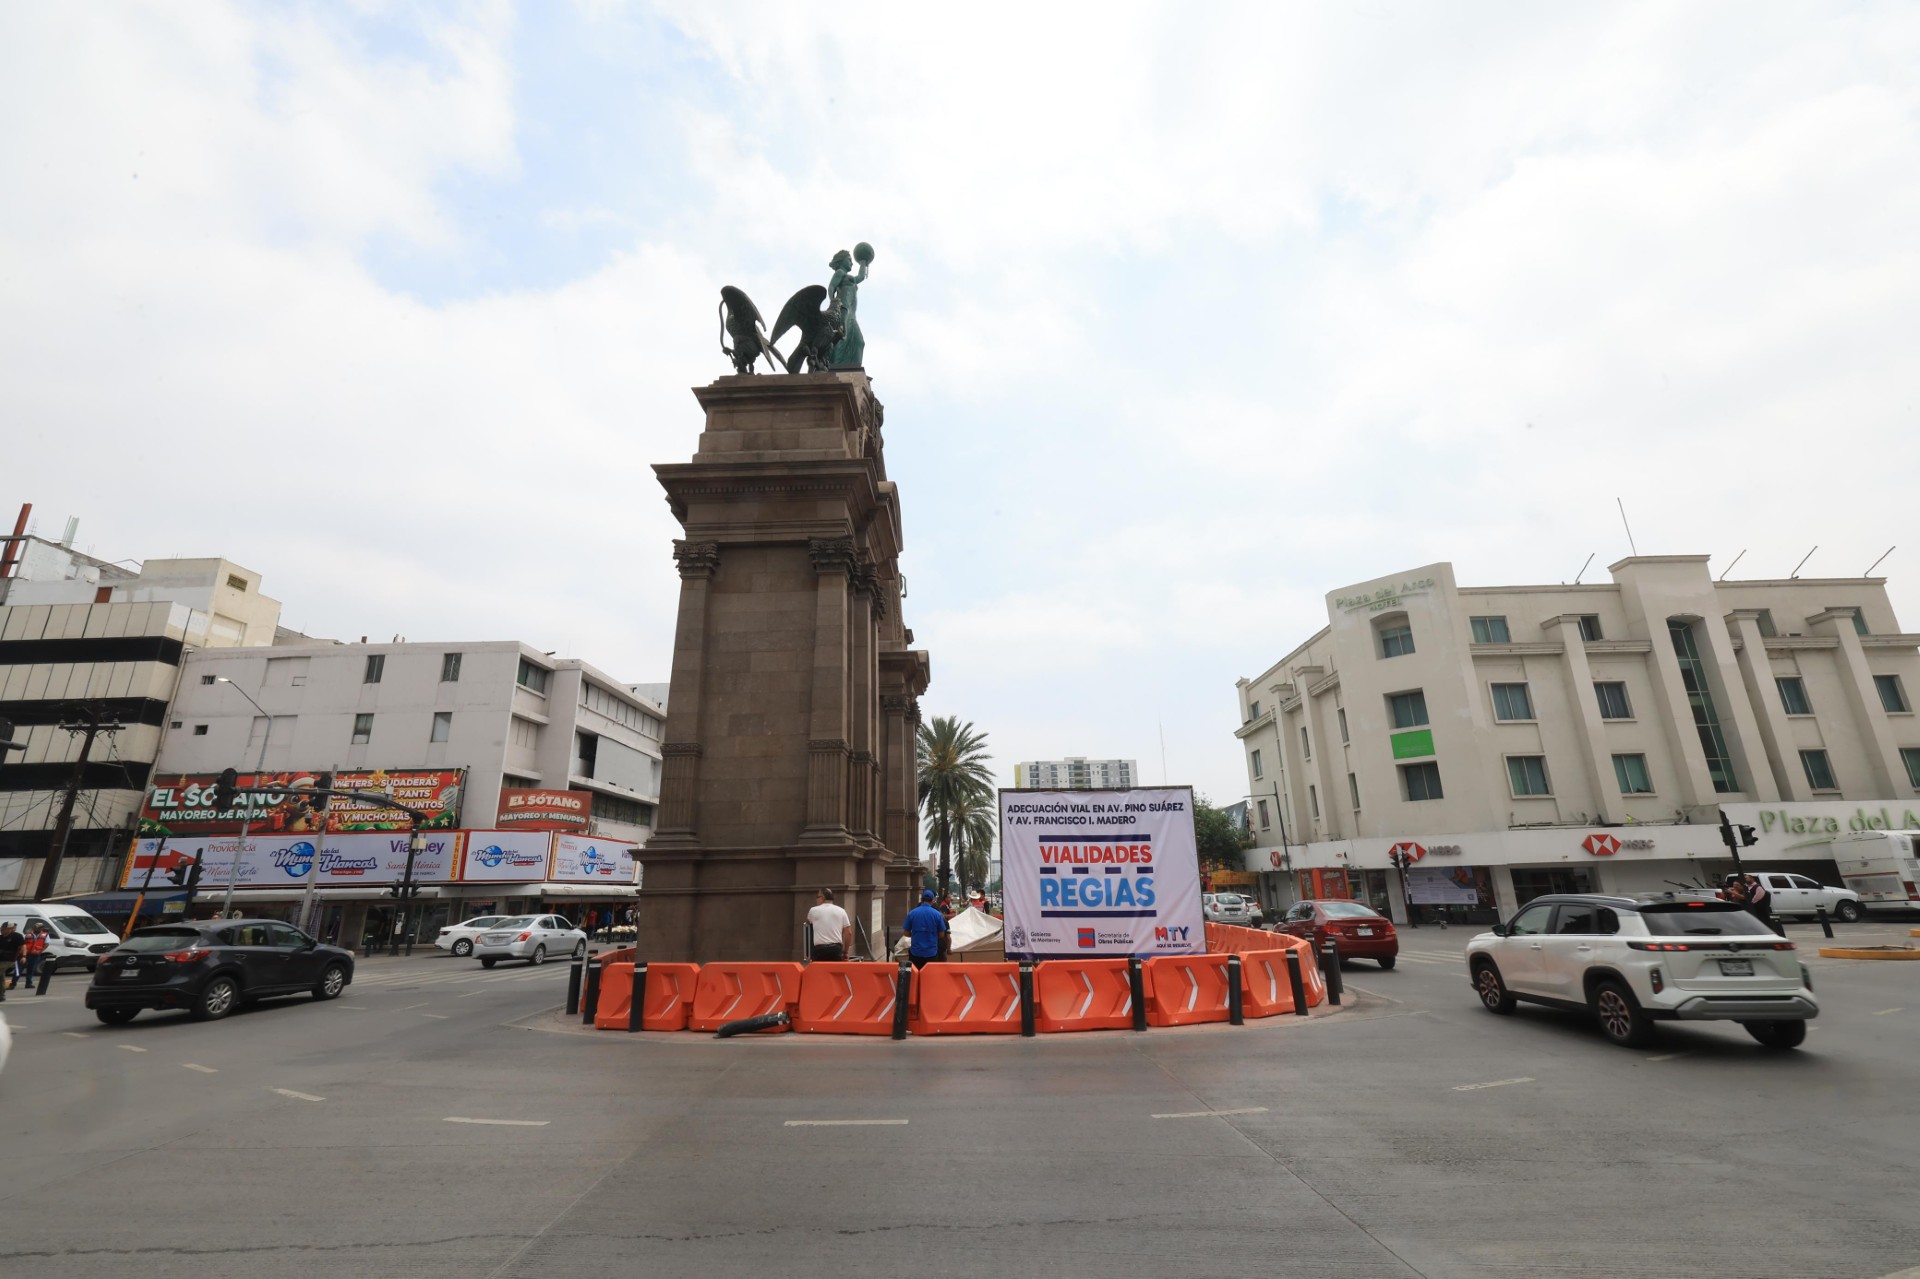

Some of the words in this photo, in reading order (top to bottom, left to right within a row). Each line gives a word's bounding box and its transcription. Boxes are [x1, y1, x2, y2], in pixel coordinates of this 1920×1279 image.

[1335, 594, 1370, 609] Plaza
[1375, 584, 1396, 599] del
[1401, 578, 1434, 593] Arco
[1369, 599, 1402, 612] HOTEL
[332, 779, 373, 788] WETERS
[381, 778, 438, 787] SUDADERAS
[151, 788, 179, 807] EL
[184, 783, 285, 807] SÓANO
[398, 790, 430, 798] PANTS
[509, 794, 525, 806] EL
[527, 792, 581, 810] SÓTANO
[1007, 801, 1068, 814] ADECUACIÓN
[1070, 804, 1090, 813] VIAL
[1092, 804, 1105, 813] EN
[1107, 804, 1122, 813] AV.
[1125, 803, 1147, 812] PINO
[1149, 800, 1184, 812] SUÁREZ
[160, 810, 216, 820] MAYOREO
[218, 809, 234, 819] DE
[343, 813, 351, 822] Y
[352, 812, 387, 821] MUCHO
[500, 812, 540, 822] MAYOREO
[549, 812, 586, 824] MENUDEO
[1007, 816, 1013, 825] Y
[1016, 816, 1032, 825] AV.
[1034, 816, 1087, 825] FRANCISCO
[1089, 816, 1095, 825] I.
[1096, 815, 1136, 825] MADERO
[1759, 809, 1840, 834] Plaza
[1850, 807, 1893, 832] del
[207, 843, 257, 853] Providecia
[390, 840, 445, 855] Viaey
[1428, 845, 1462, 856] HSBC
[1622, 840, 1656, 850] HSBC
[274, 848, 325, 868] Muno
[1039, 844, 1153, 864] VIALIDADES
[1040, 876, 1156, 908] REGIAS
[1154, 926, 1190, 941] MTY
